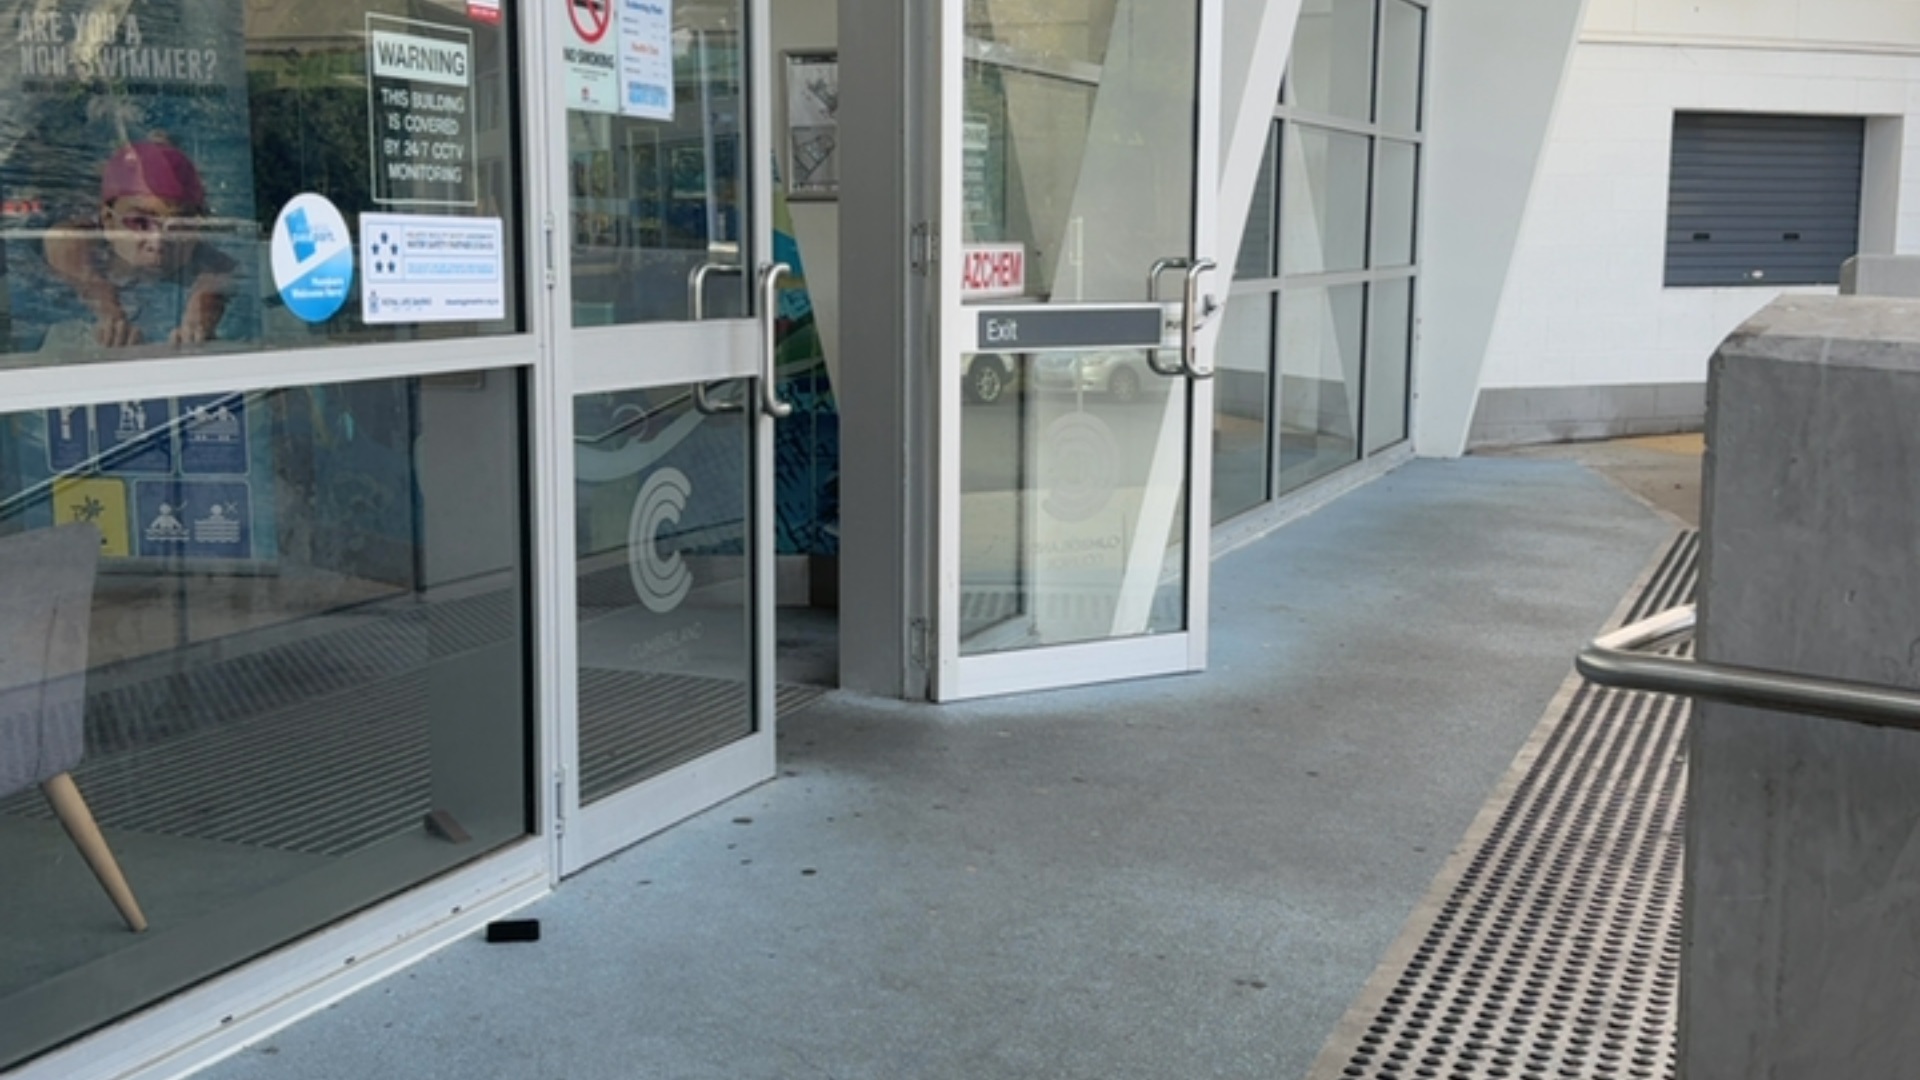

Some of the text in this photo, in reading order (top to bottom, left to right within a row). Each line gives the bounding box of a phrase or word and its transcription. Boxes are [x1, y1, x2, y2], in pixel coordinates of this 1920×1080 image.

[18, 10, 142, 46] ARE YOU A
[377, 40, 466, 76] WARNING
[562, 47, 577, 62] NO
[578, 49, 614, 69] SMOKING
[381, 88, 465, 113] THIS BUILDING
[388, 113, 459, 135] IS COVERED
[383, 138, 400, 156] BY
[432, 142, 465, 160] CCTV
[388, 162, 462, 184] MONITORING
[986, 319, 1018, 341] Exit
